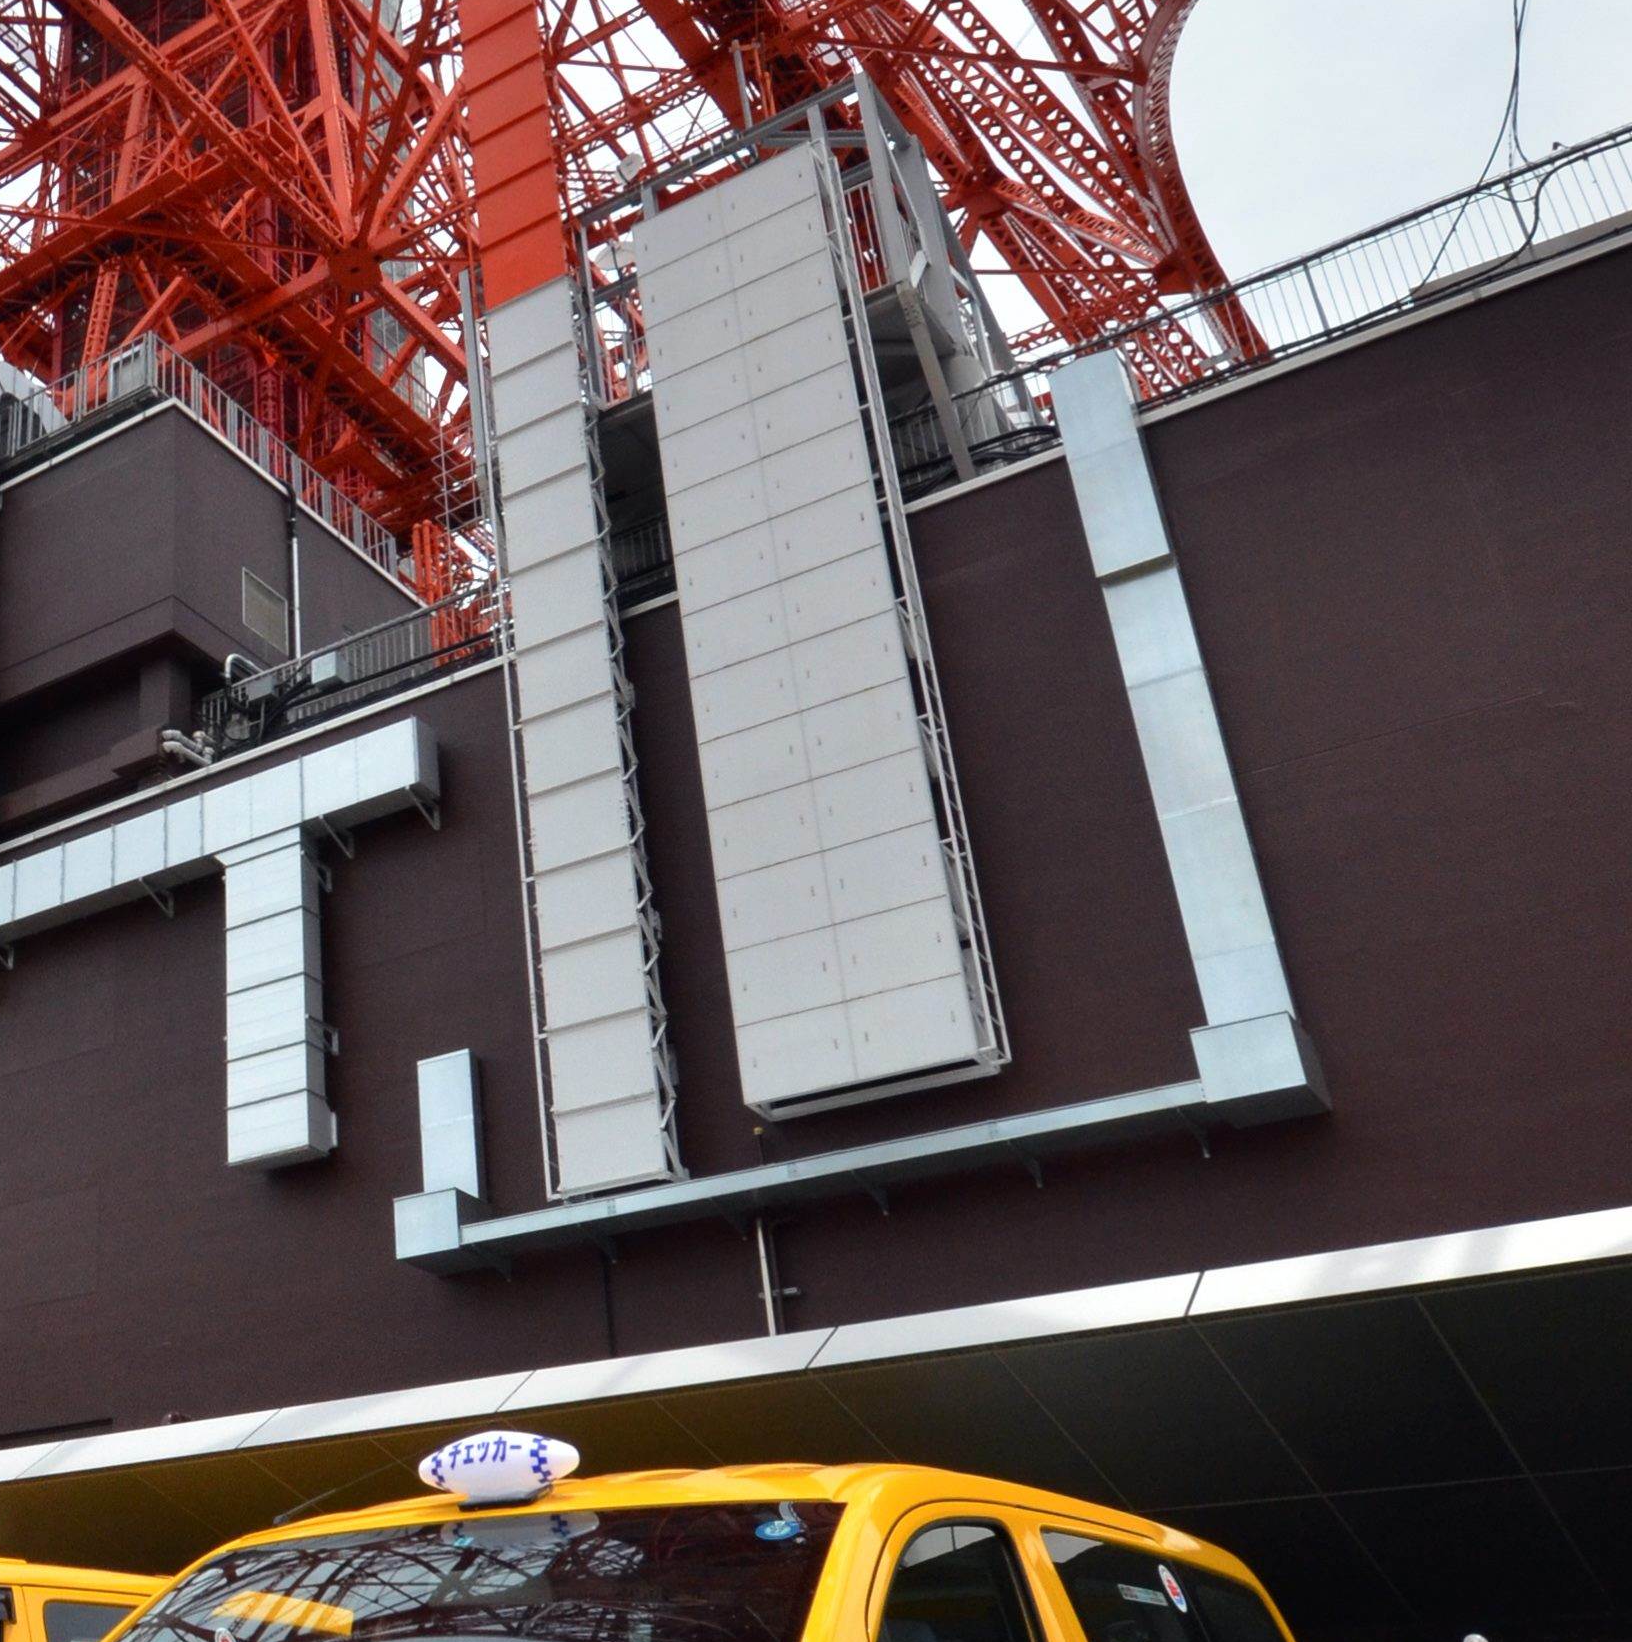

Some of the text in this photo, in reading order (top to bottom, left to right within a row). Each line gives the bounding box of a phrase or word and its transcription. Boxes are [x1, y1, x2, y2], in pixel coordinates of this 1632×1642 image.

[448, 1436, 522, 1470] チェッカー
